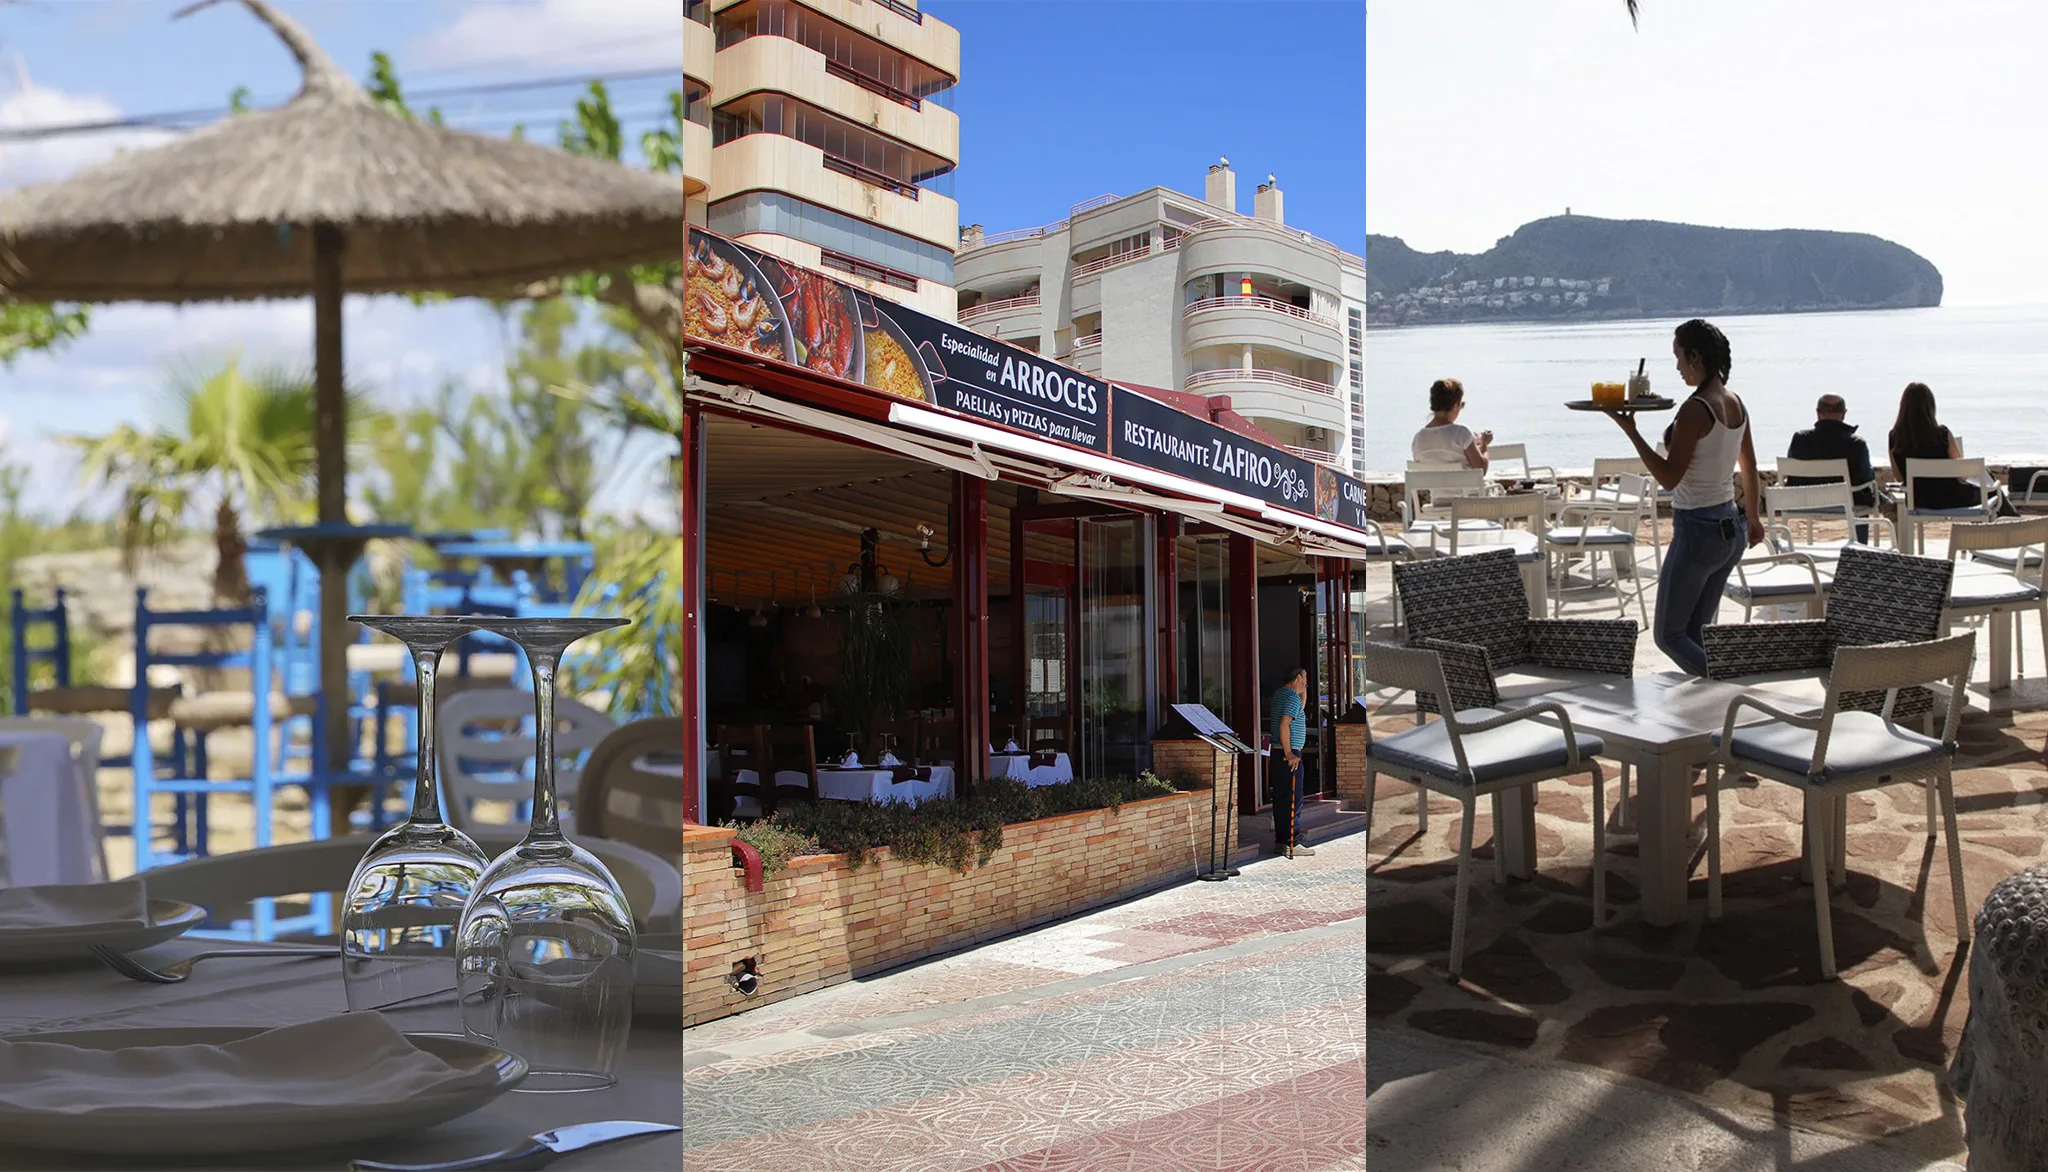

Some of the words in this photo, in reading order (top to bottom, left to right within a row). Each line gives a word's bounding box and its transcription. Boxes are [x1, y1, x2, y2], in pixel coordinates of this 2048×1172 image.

[941, 333, 1000, 367] Especialidad
[985, 369, 997, 383] en
[1000, 356, 1098, 415] ARROCES
[956, 390, 1002, 419] PAELLAS
[1003, 409, 1011, 425] y
[1012, 408, 1048, 432] PIZZAS
[1049, 422, 1070, 439] para
[1071, 425, 1097, 446] llevar
[1124, 420, 1210, 468] RESTAURANTE
[1212, 438, 1272, 488] ZAFIRO
